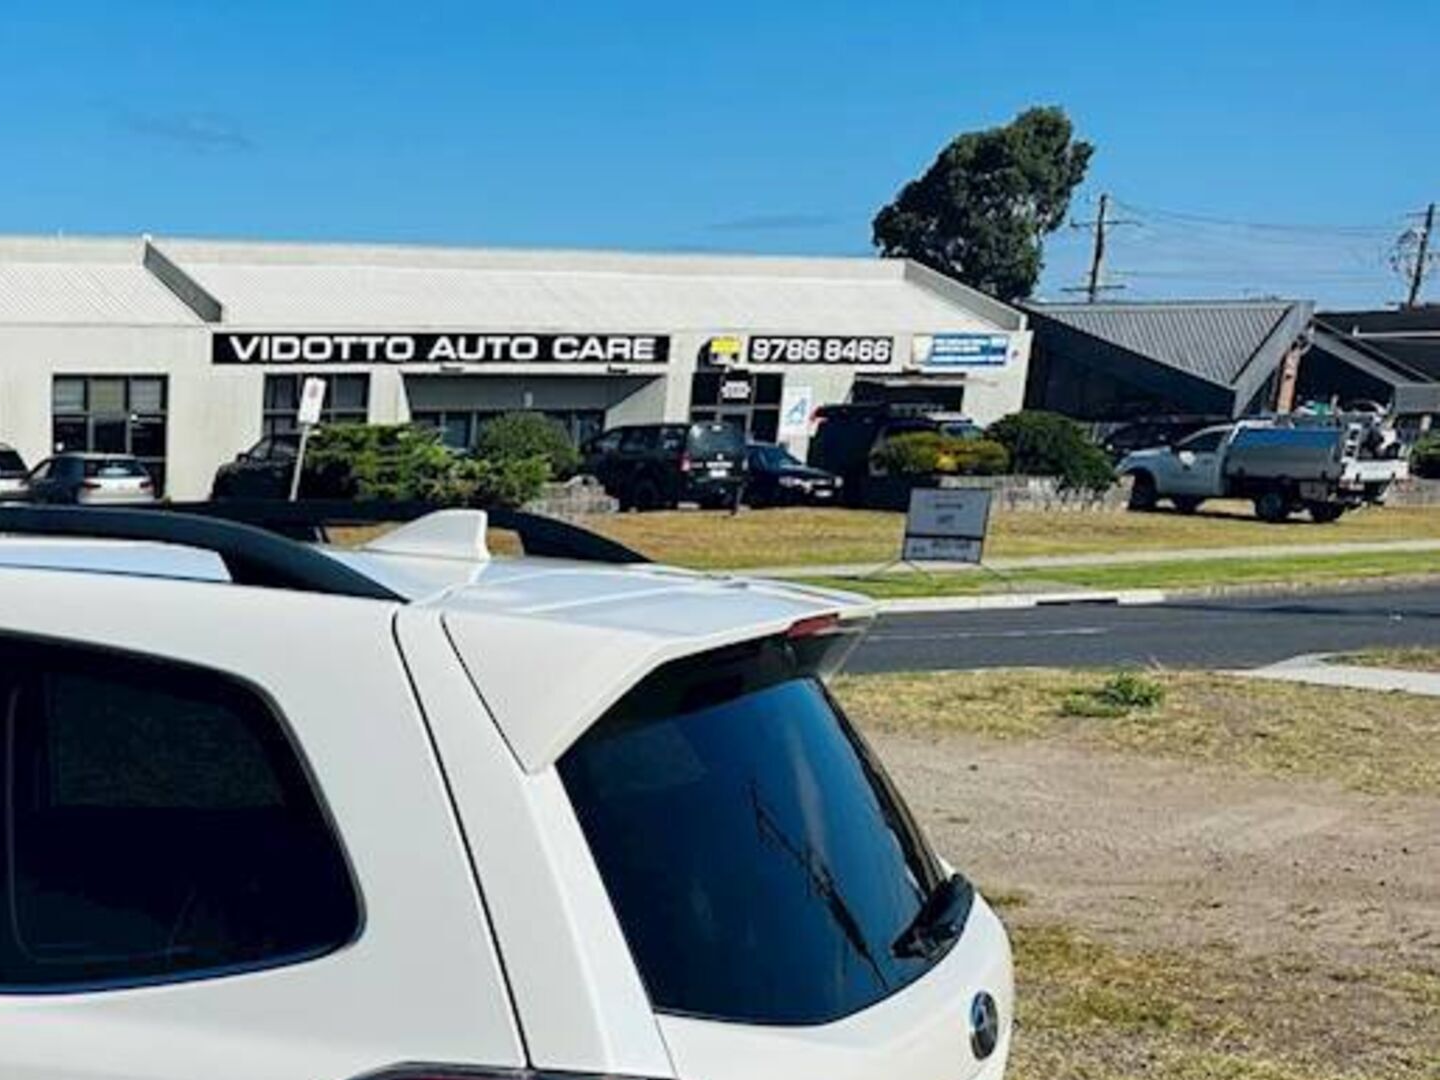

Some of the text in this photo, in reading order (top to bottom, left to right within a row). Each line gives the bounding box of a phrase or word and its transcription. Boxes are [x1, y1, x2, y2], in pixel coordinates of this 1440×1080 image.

[228, 335, 657, 361] VIDOTTO AUTO CARE
[752, 338, 821, 361] 9786
[824, 338, 890, 362] 8466
